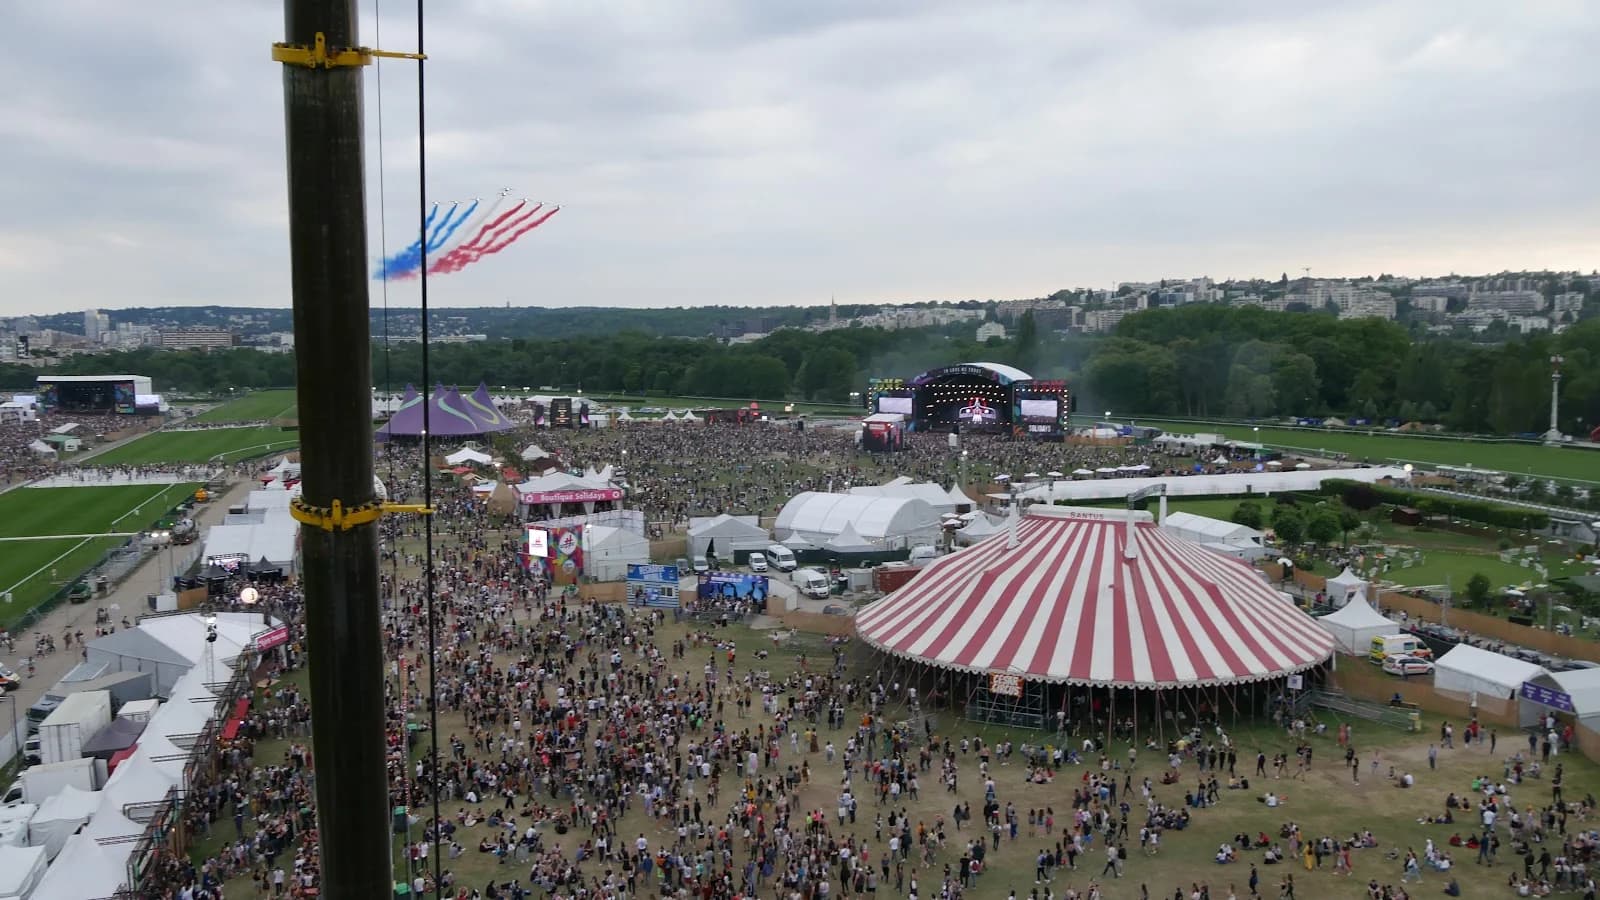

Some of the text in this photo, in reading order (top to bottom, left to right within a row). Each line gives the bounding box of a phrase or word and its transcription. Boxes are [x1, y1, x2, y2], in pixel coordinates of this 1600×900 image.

[1028, 425, 1051, 433] SOLIDAYS
[540, 491, 606, 503] Boutique Solidays
[1070, 511, 1104, 519] SANTUS
